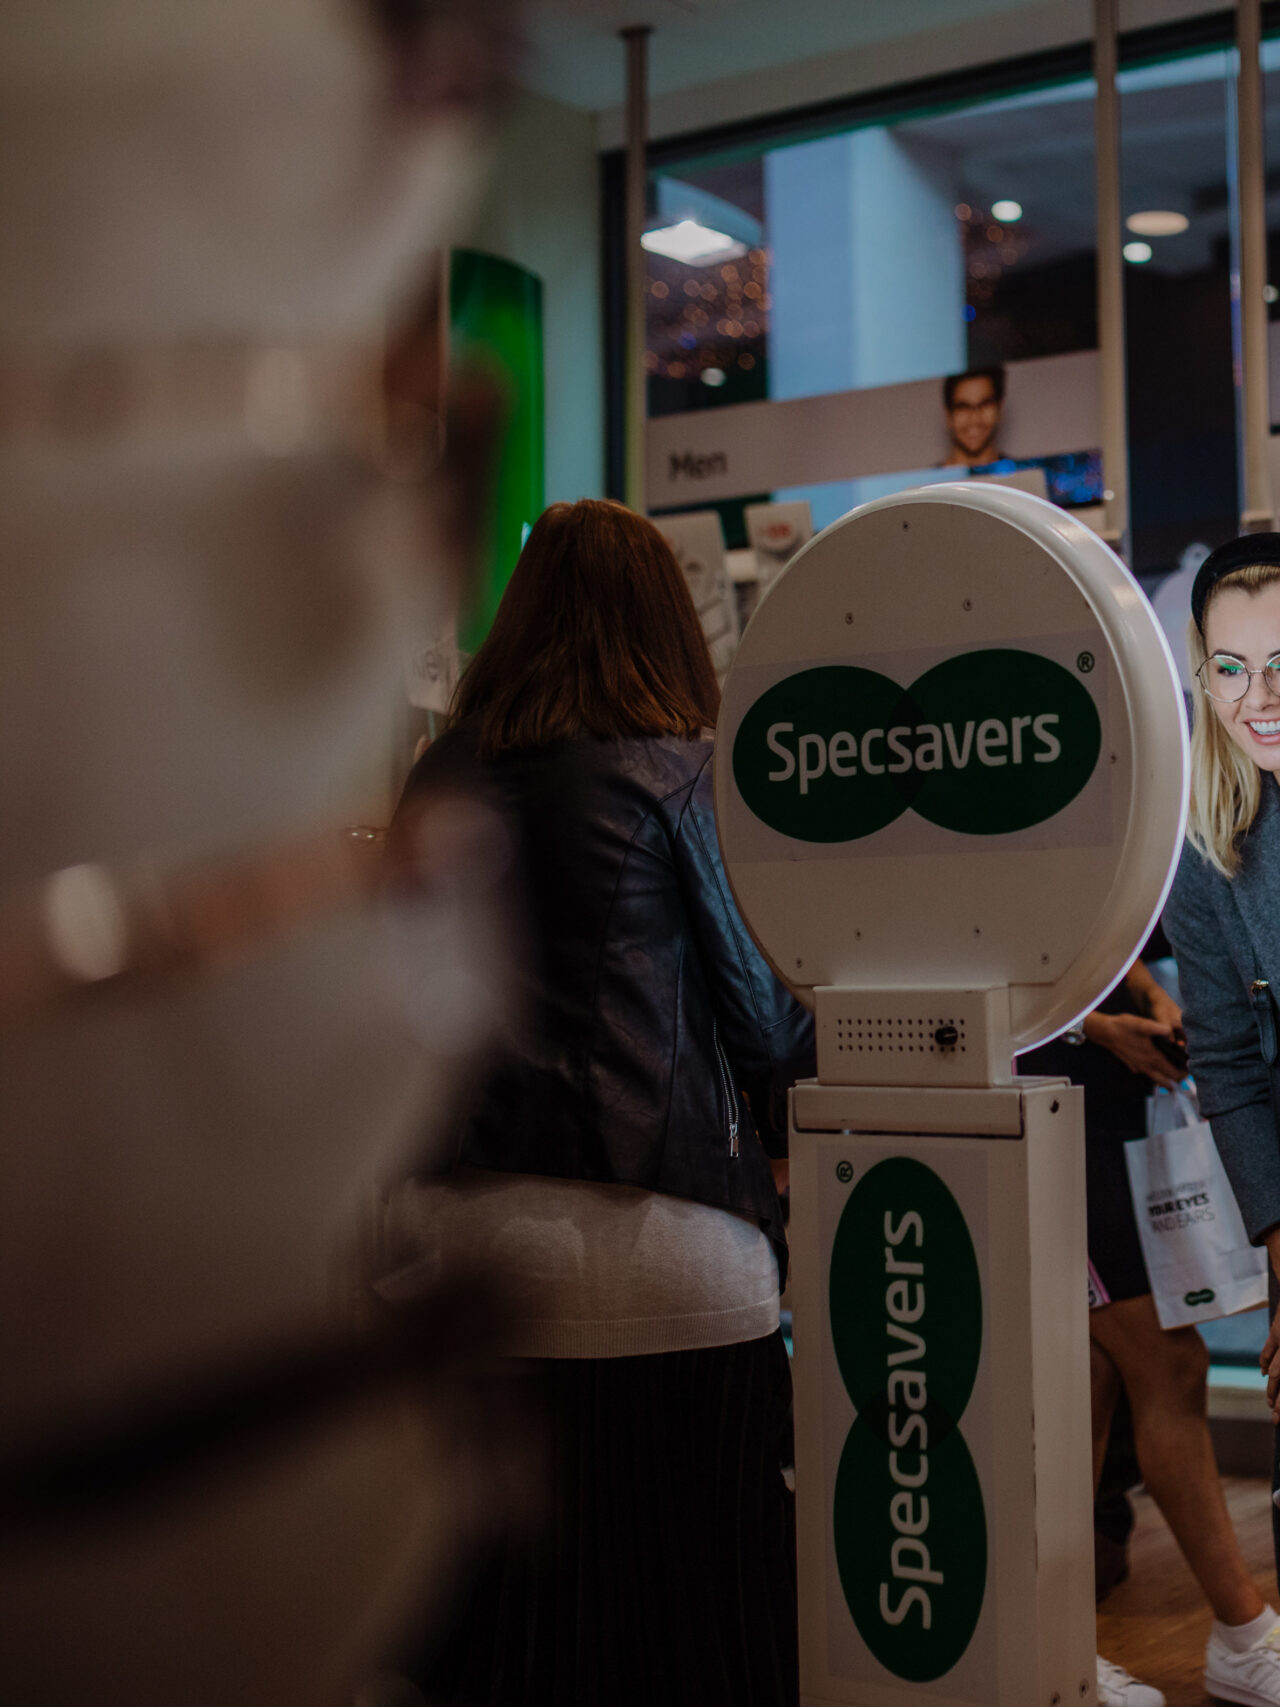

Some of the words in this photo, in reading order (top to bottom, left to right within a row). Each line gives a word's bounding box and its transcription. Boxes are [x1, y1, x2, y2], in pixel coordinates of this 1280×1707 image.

[667, 449, 727, 481] Men
[766, 713, 1061, 795] Specsavers
[1175, 1192, 1210, 1212] EYES
[879, 1209, 944, 1630] Specsavers
